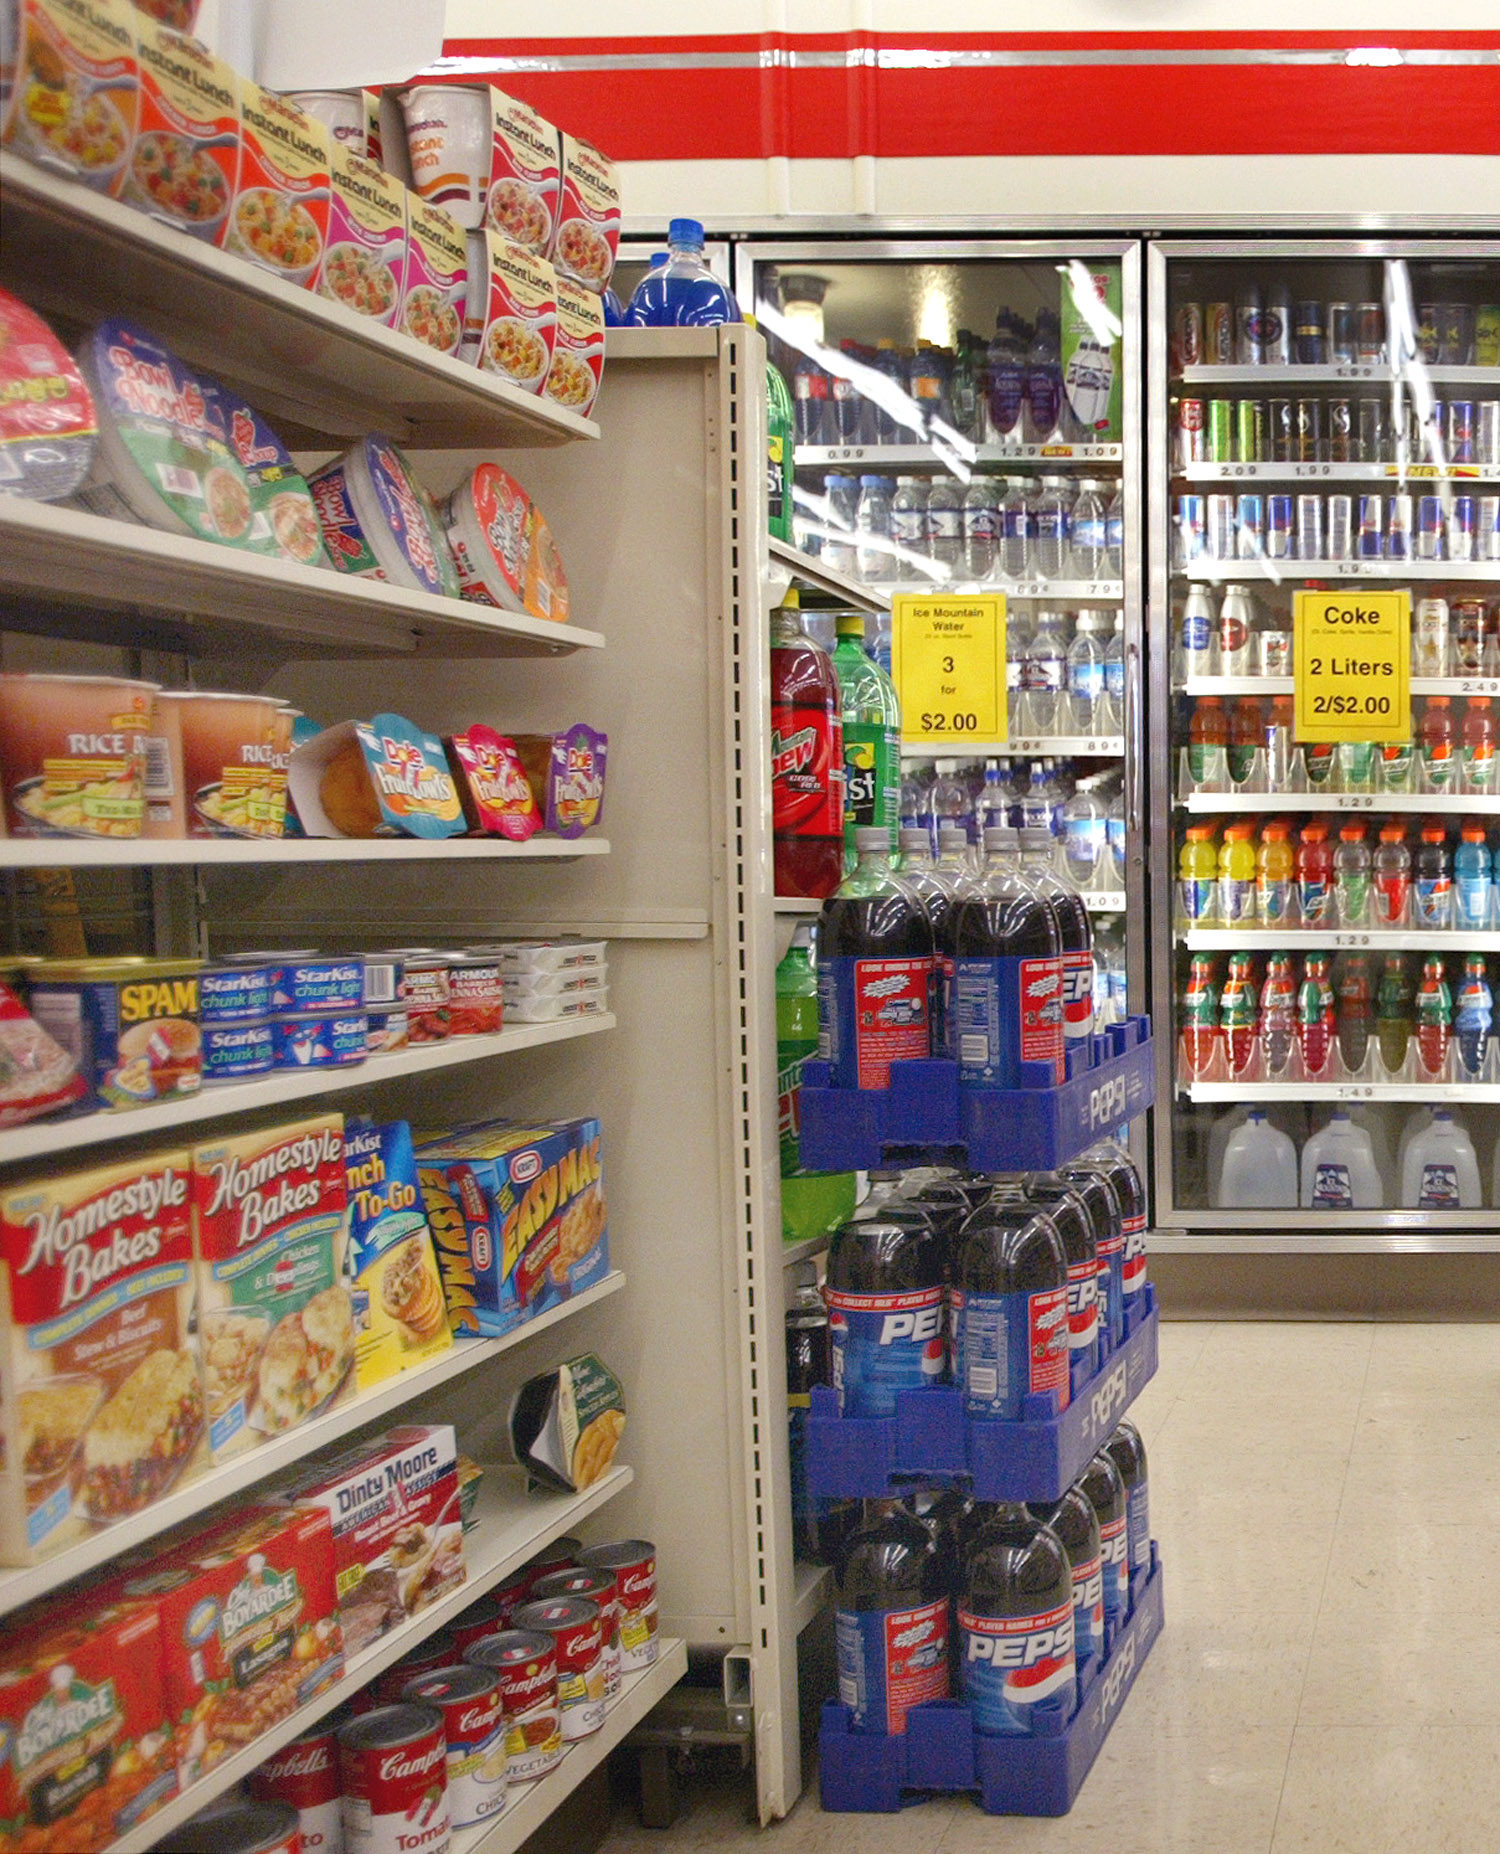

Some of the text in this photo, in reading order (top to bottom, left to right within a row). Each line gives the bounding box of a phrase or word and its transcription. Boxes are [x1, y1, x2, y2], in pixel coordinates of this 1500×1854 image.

[192, 68, 235, 108] Lunch
[290, 127, 327, 165] Lunch
[496, 112, 557, 160] Instant Lunch
[332, 169, 372, 202] Instant
[371, 185, 402, 217] Lunch
[568, 158, 599, 186] Instant
[597, 177, 619, 202] Lunch
[493, 253, 553, 297] Instant Lunch
[579, 301, 601, 325] Lunch
[913, 607, 984, 618] Ice Mountain
[933, 622, 964, 632] Water
[1324, 606, 1380, 624] Coke
[942, 656, 955, 674] 3
[1310, 658, 1394, 676] 2 Liters
[941, 685, 956, 695] for
[1314, 696, 1390, 715] 2/$2.00
[921, 713, 978, 733] $2.00
[68, 733, 126, 755] RICE
[382, 737, 425, 769] Dole
[844, 769, 875, 800] ist
[121, 979, 198, 1021] SPAM
[201, 993, 247, 1009] chunk
[295, 984, 338, 998] chunk
[210, 1047, 252, 1065] chunk
[345, 1132, 382, 1157] arKist
[205, 1127, 343, 1217] Homestyle
[346, 1153, 385, 1191] nch
[237, 1178, 322, 1249] Bakes
[355, 1181, 416, 1223] To-Go
[17, 1167, 188, 1277] Homestyle
[59, 1226, 164, 1311] Bakes
[336, 1478, 384, 1513] Dinty
[384, 1446, 438, 1489] Moore
[624, 1573, 655, 1595] Camp
[222, 1576, 296, 1638] BOYARDEE
[566, 1631, 600, 1657] Camp
[460, 1706, 502, 1733] Camp
[381, 1735, 448, 1781] Campb
